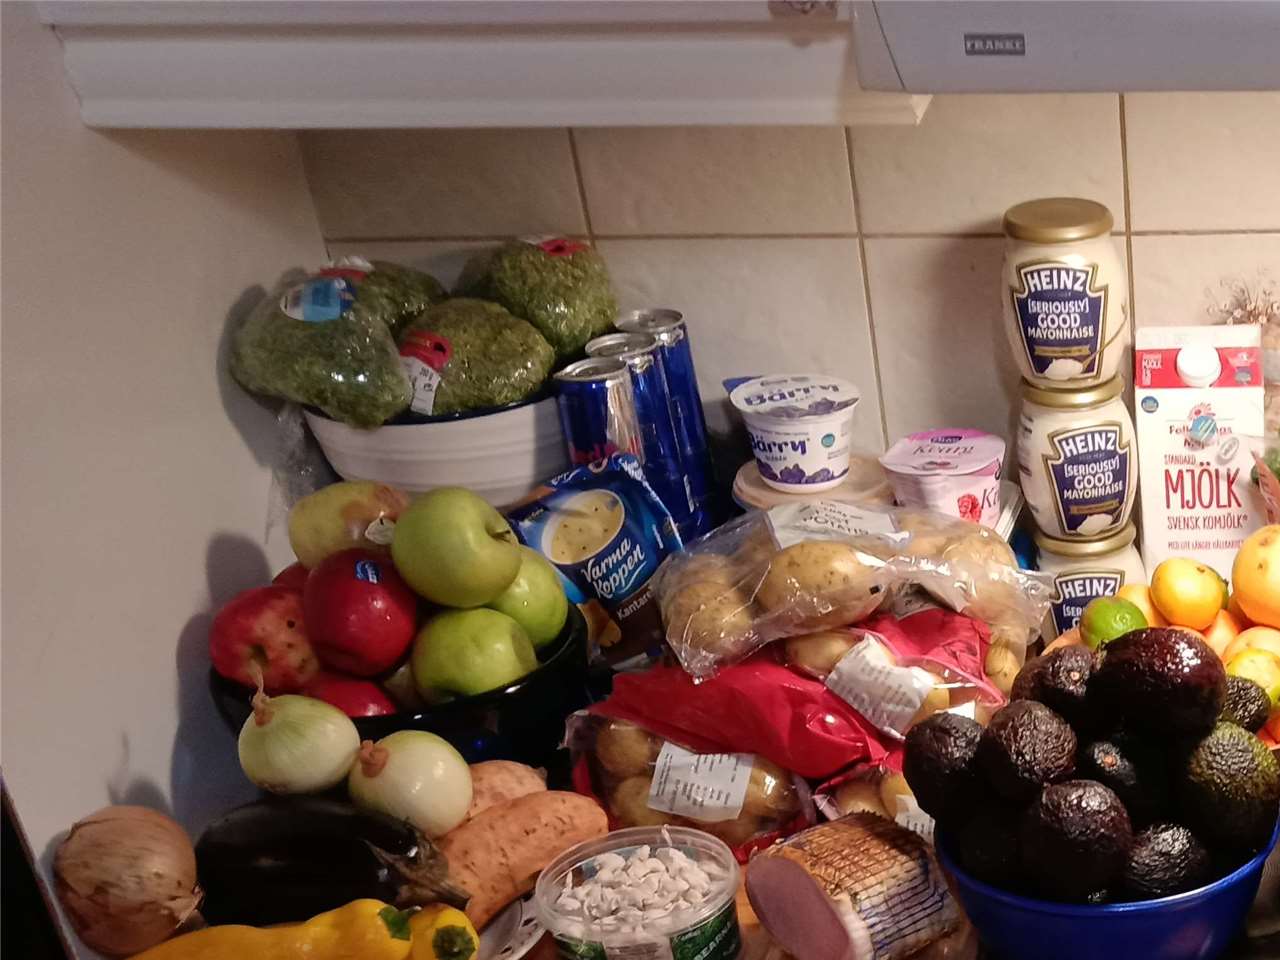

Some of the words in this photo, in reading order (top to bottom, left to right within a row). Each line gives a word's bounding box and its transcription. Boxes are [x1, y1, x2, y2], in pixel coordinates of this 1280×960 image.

[1026, 269, 1087, 293] HEINZ
[1037, 313, 1081, 329] GOOD
[1027, 325, 1094, 340] MAYONNAISE
[1061, 432, 1116, 458] HEINZ
[1063, 480, 1123, 500] MAYONNAISE
[1074, 471, 1114, 489] GOOD
[1164, 461, 1242, 510] MJÖLK
[1167, 515, 1201, 530] SVENSK
[581, 538, 631, 582] Varma
[593, 544, 645, 599] Koppen
[1062, 578, 1116, 600] HEINZ
